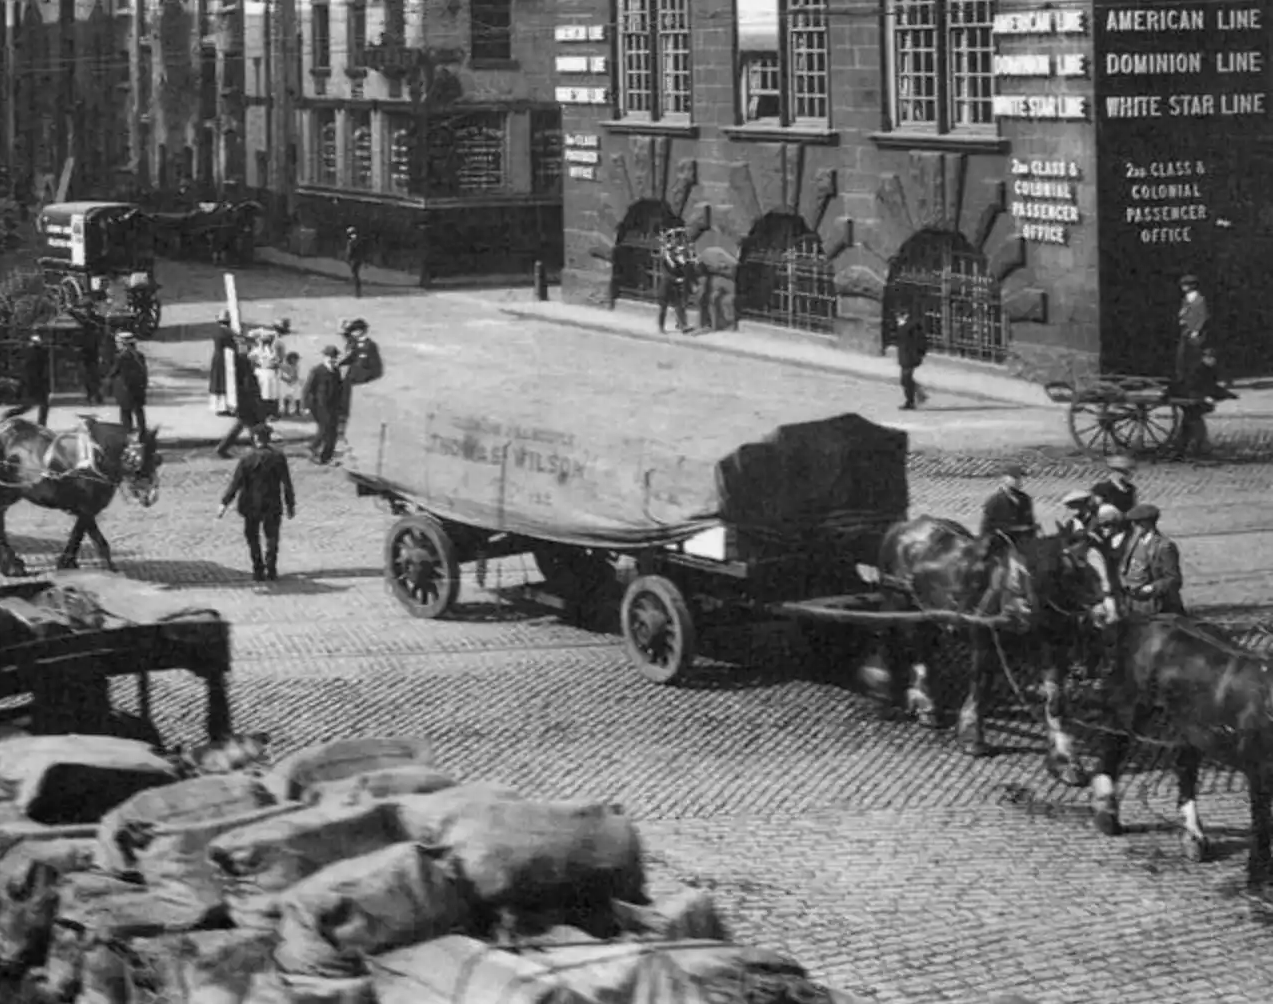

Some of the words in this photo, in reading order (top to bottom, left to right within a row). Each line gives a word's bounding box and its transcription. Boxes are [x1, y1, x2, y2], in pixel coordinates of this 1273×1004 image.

[1106, 9, 1204, 31] AMERICAN
[1217, 8, 1262, 30] LINE
[1106, 52, 1201, 75] DOMINION
[1216, 51, 1262, 73] LINE
[1106, 95, 1162, 118] WHITE
[1169, 94, 1214, 116] STAR
[1220, 92, 1266, 115] LINE
[1150, 160, 1192, 177] CLASS
[1131, 183, 1202, 200] COLONIAL
[1010, 200, 1080, 222] PASSENGER
[1126, 204, 1208, 223] PASSENGER
[1021, 223, 1065, 244] OFFICE
[1140, 226, 1192, 244] OFFICE
